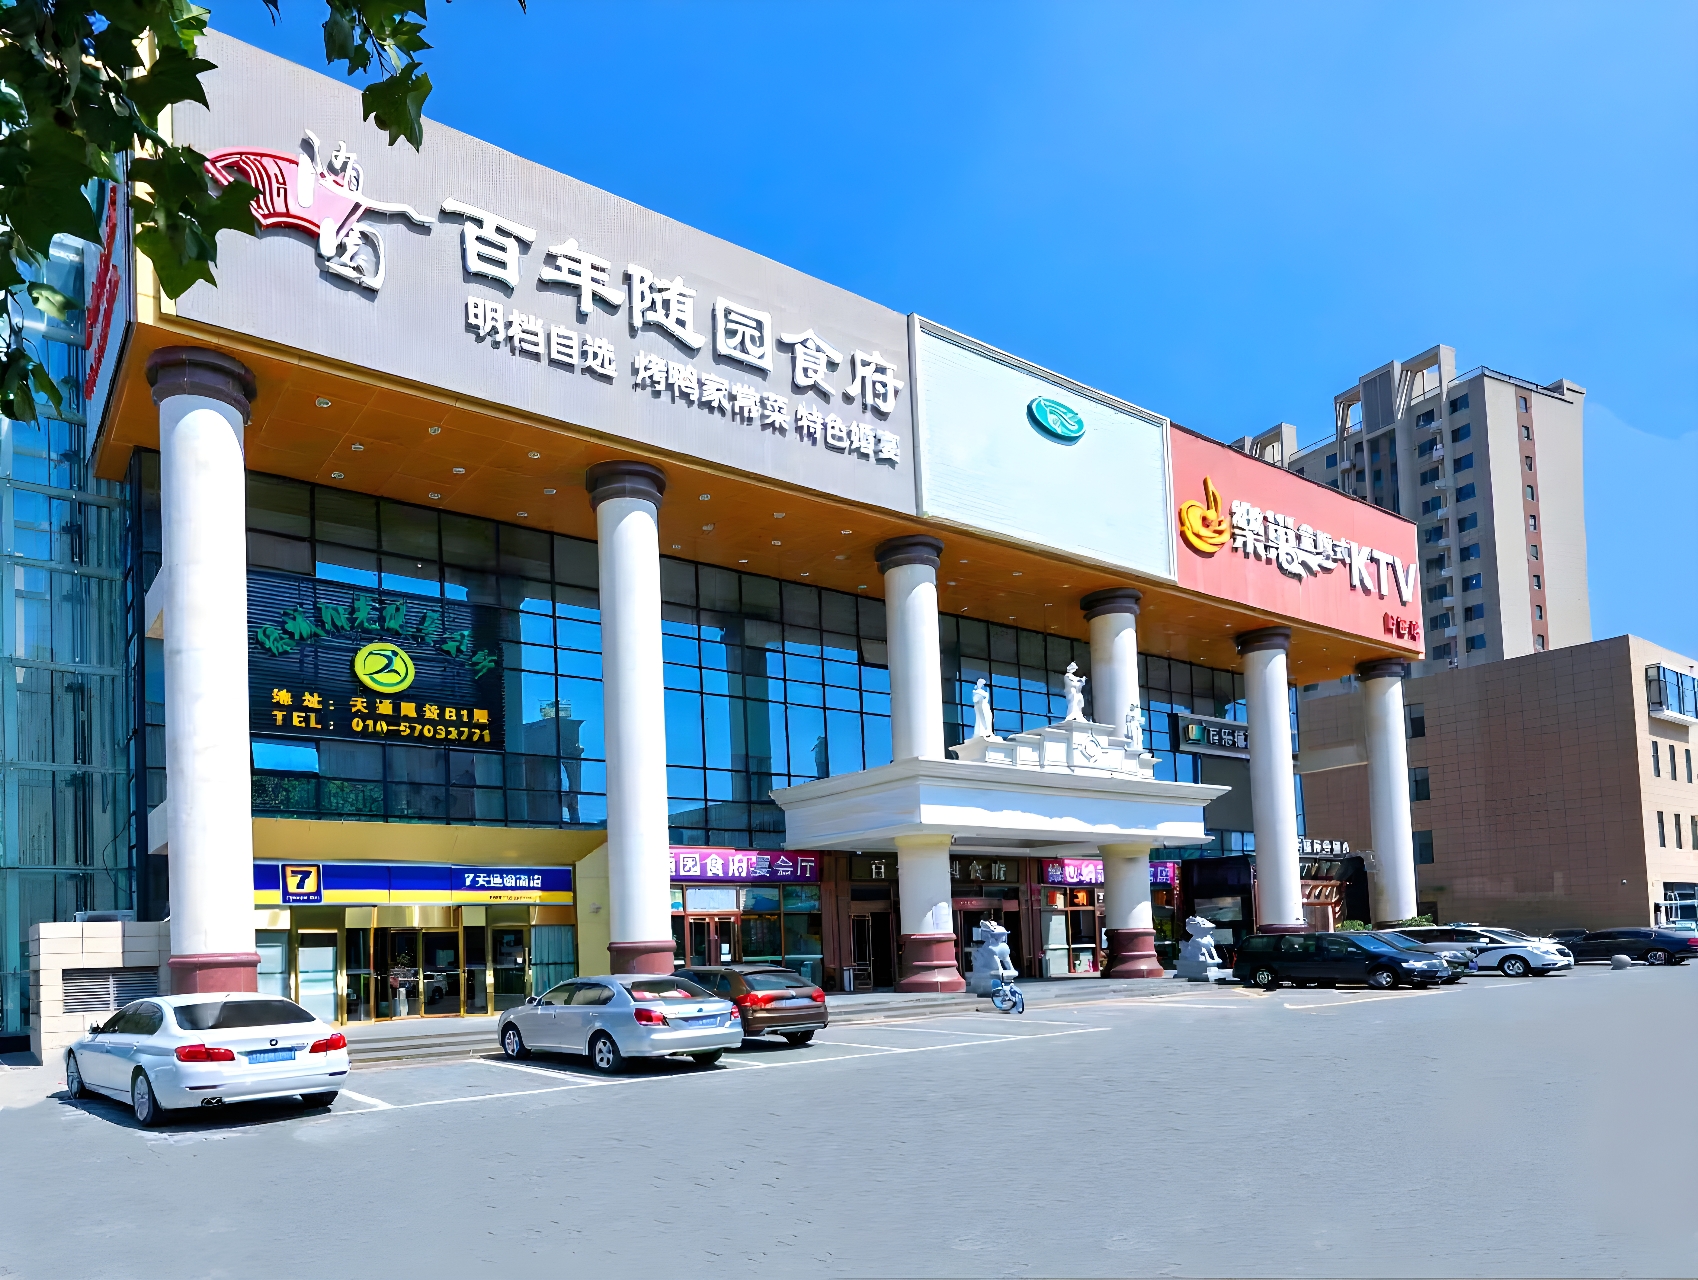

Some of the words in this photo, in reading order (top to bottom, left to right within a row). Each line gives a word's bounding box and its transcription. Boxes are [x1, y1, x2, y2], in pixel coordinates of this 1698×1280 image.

[441, 197, 904, 412] 百年随园食府
[467, 296, 618, 378] 明档自选
[635, 350, 790, 430] 烤鸭家常菜
[290, 869, 313, 890] 7
